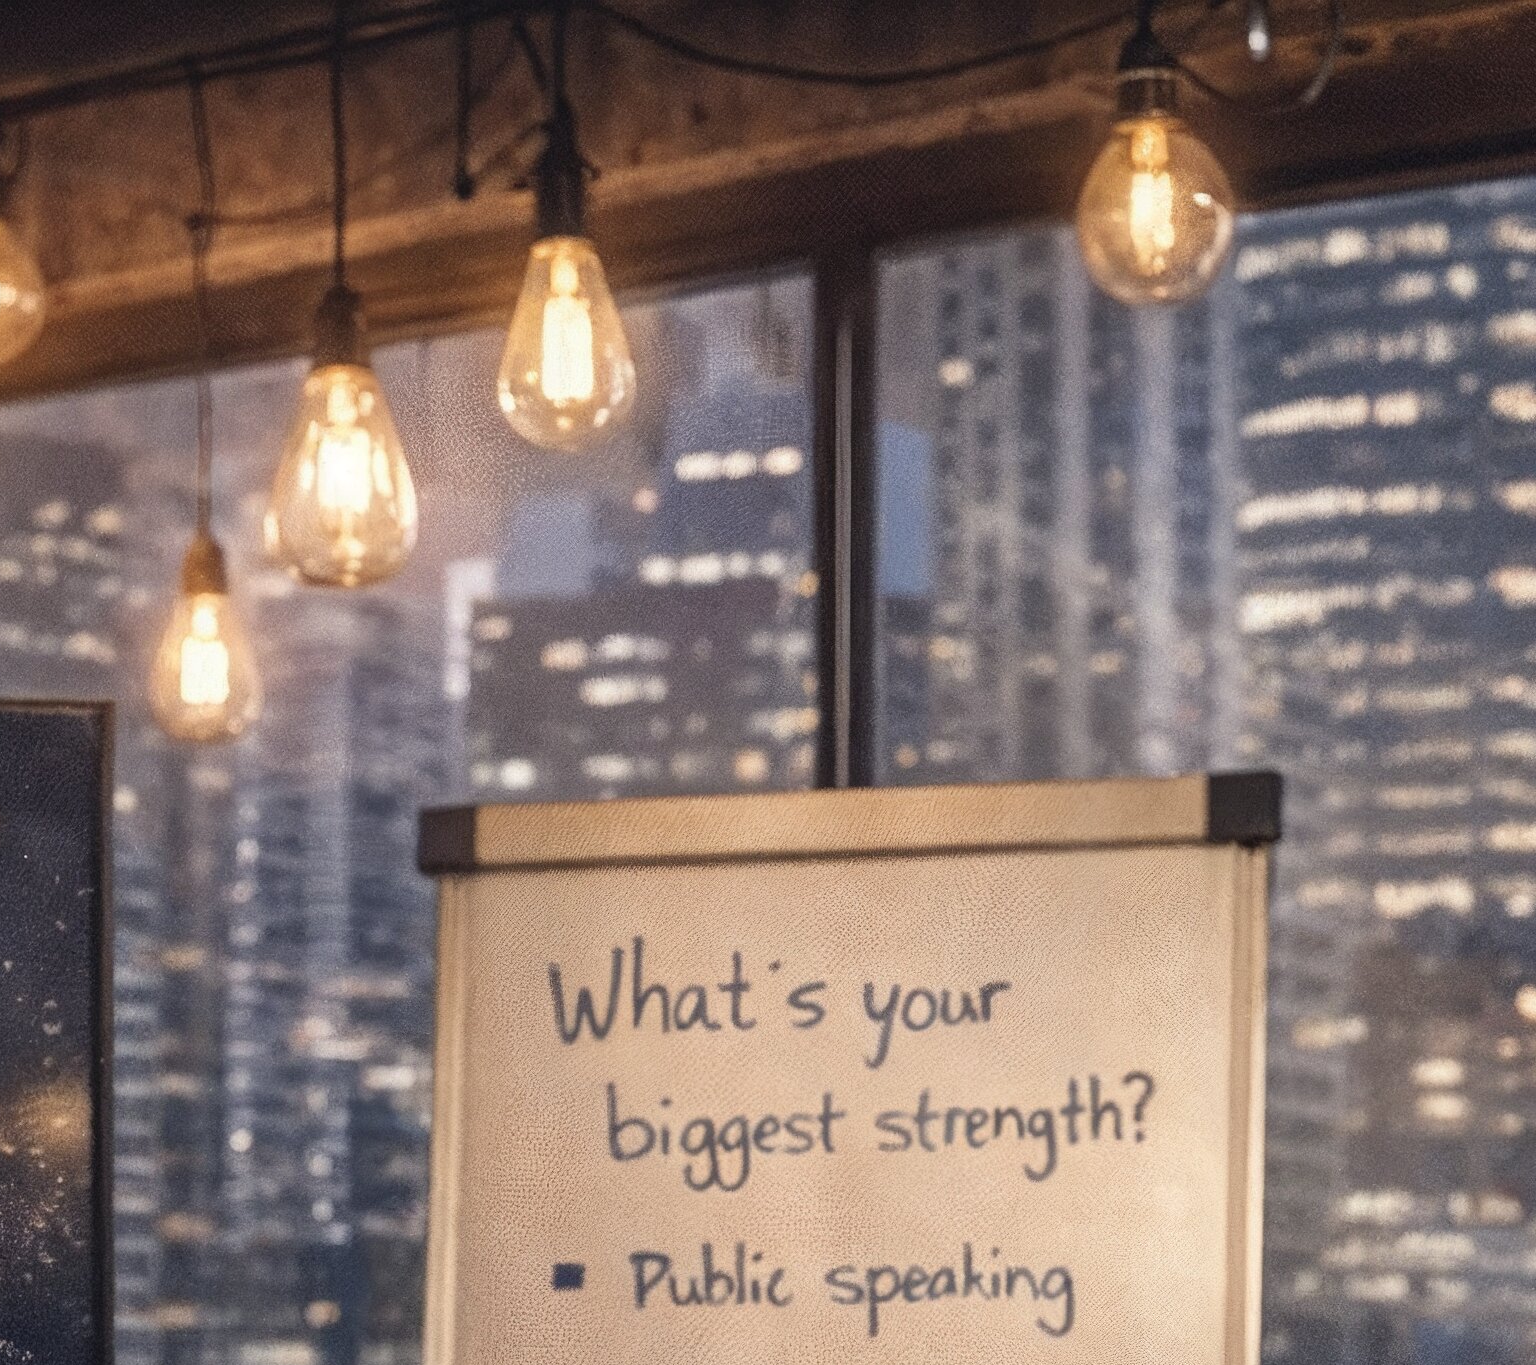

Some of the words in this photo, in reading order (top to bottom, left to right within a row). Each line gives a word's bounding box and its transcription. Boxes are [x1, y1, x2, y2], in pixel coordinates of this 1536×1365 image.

[547, 934, 830, 1046] What's
[861, 978, 1013, 1070] your
[605, 1081, 847, 1193] biggest
[874, 1069, 1157, 1184] strength?
[627, 1242, 794, 1310] Public
[822, 1245, 1078, 1339] speaking
